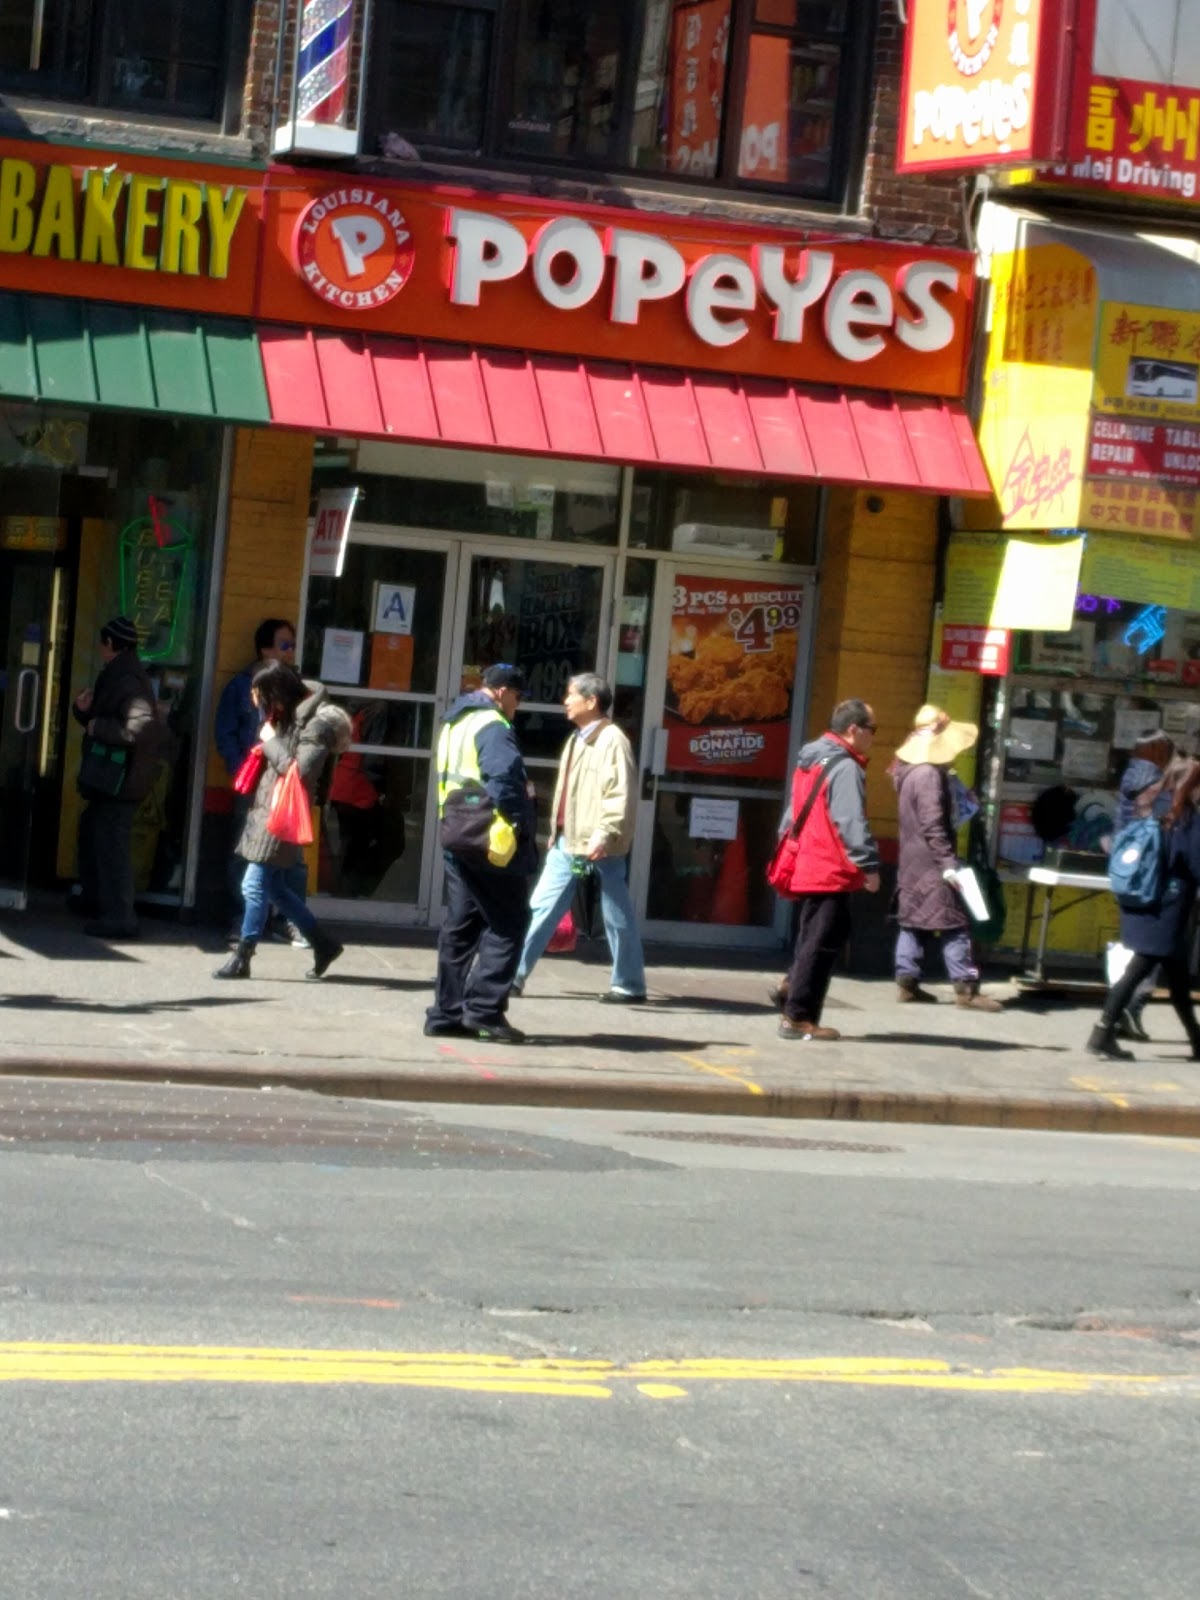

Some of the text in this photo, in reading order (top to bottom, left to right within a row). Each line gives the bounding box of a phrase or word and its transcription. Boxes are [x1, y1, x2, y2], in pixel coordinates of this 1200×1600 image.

[1117, 159, 1196, 198] Driving
[1, 158, 247, 279] BAKERY
[303, 189, 410, 245] LOUISIANA
[331, 214, 386, 278] P
[304, 261, 403, 307] KITCHEN
[1091, 442, 1136, 465] REPAIR
[1165, 427, 1200, 449] TABL
[382, 591, 406, 621] A
[689, 591, 728, 606] PCS
[743, 590, 802, 604] BISCUIT
[689, 735, 765, 753] BONAFIDE
